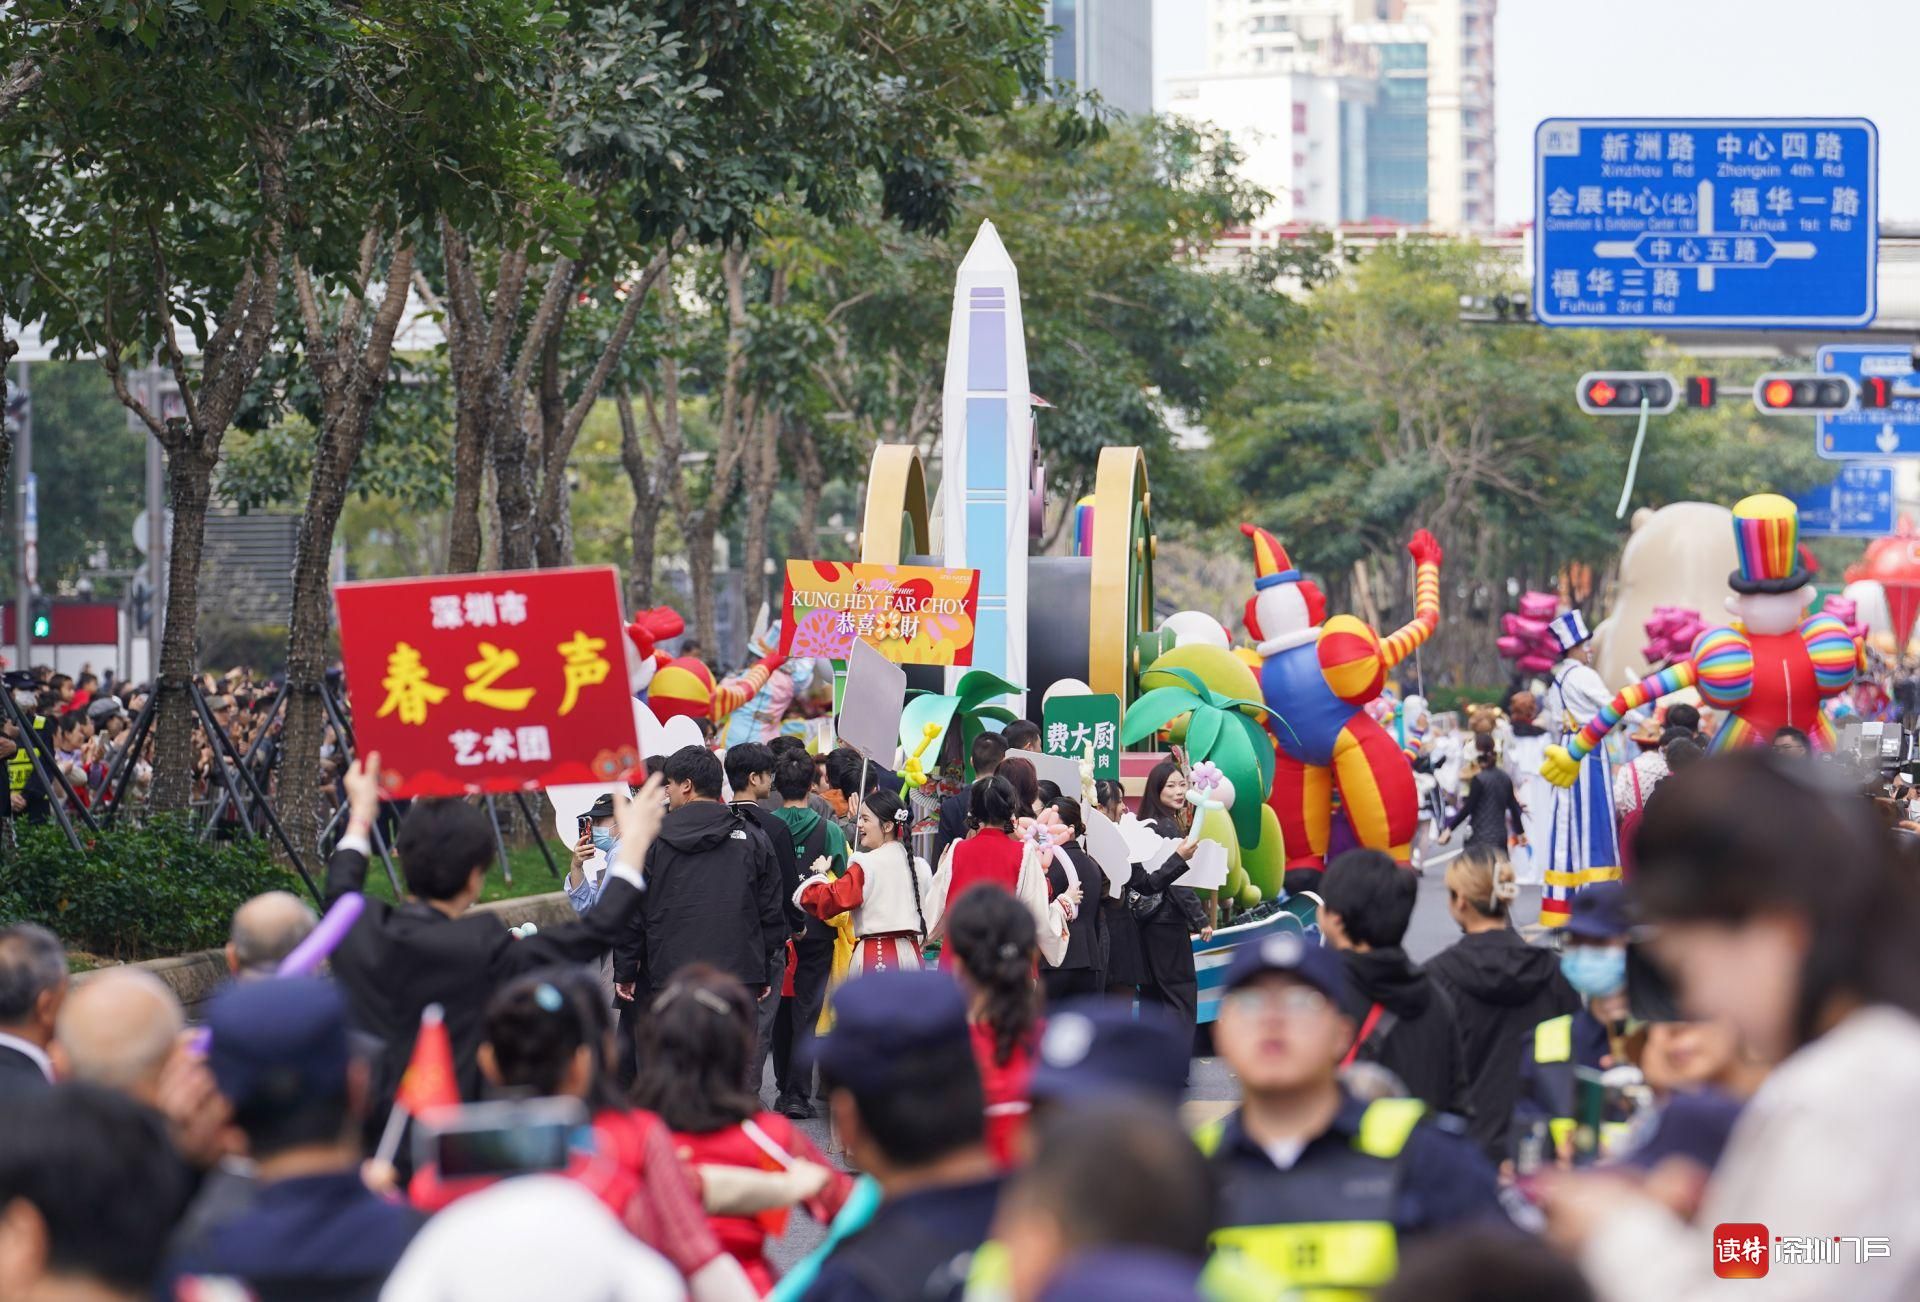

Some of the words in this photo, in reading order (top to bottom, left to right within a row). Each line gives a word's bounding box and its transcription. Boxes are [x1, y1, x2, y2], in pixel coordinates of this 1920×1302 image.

[1601, 132, 1695, 161] 新洲路
[1717, 132, 1842, 161] 中心四路
[1673, 163, 1694, 177] Rd
[1717, 163, 1782, 180] Zhongxin
[1790, 163, 1814, 177] 4th
[1823, 163, 1845, 177] Rd
[1731, 186, 1859, 217] 福华一路
[1830, 217, 1851, 231] Rd
[1651, 238, 1758, 262] 中心五路
[1551, 268, 1681, 297] 福华三路
[1617, 300, 1644, 313] 3rd
[1653, 300, 1675, 313] Rd
[852, 579, 875, 594] One
[877, 580, 915, 595] Avenue
[430, 590, 528, 629] 深圳市
[791, 590, 840, 608] KUNG
[844, 594, 880, 611] HEY
[884, 596, 917, 613] FAR
[920, 598, 970, 615] CHOY
[376, 630, 610, 725] 春之声
[449, 725, 551, 765] 艺术团
[1047, 721, 1116, 754] 费大厨
